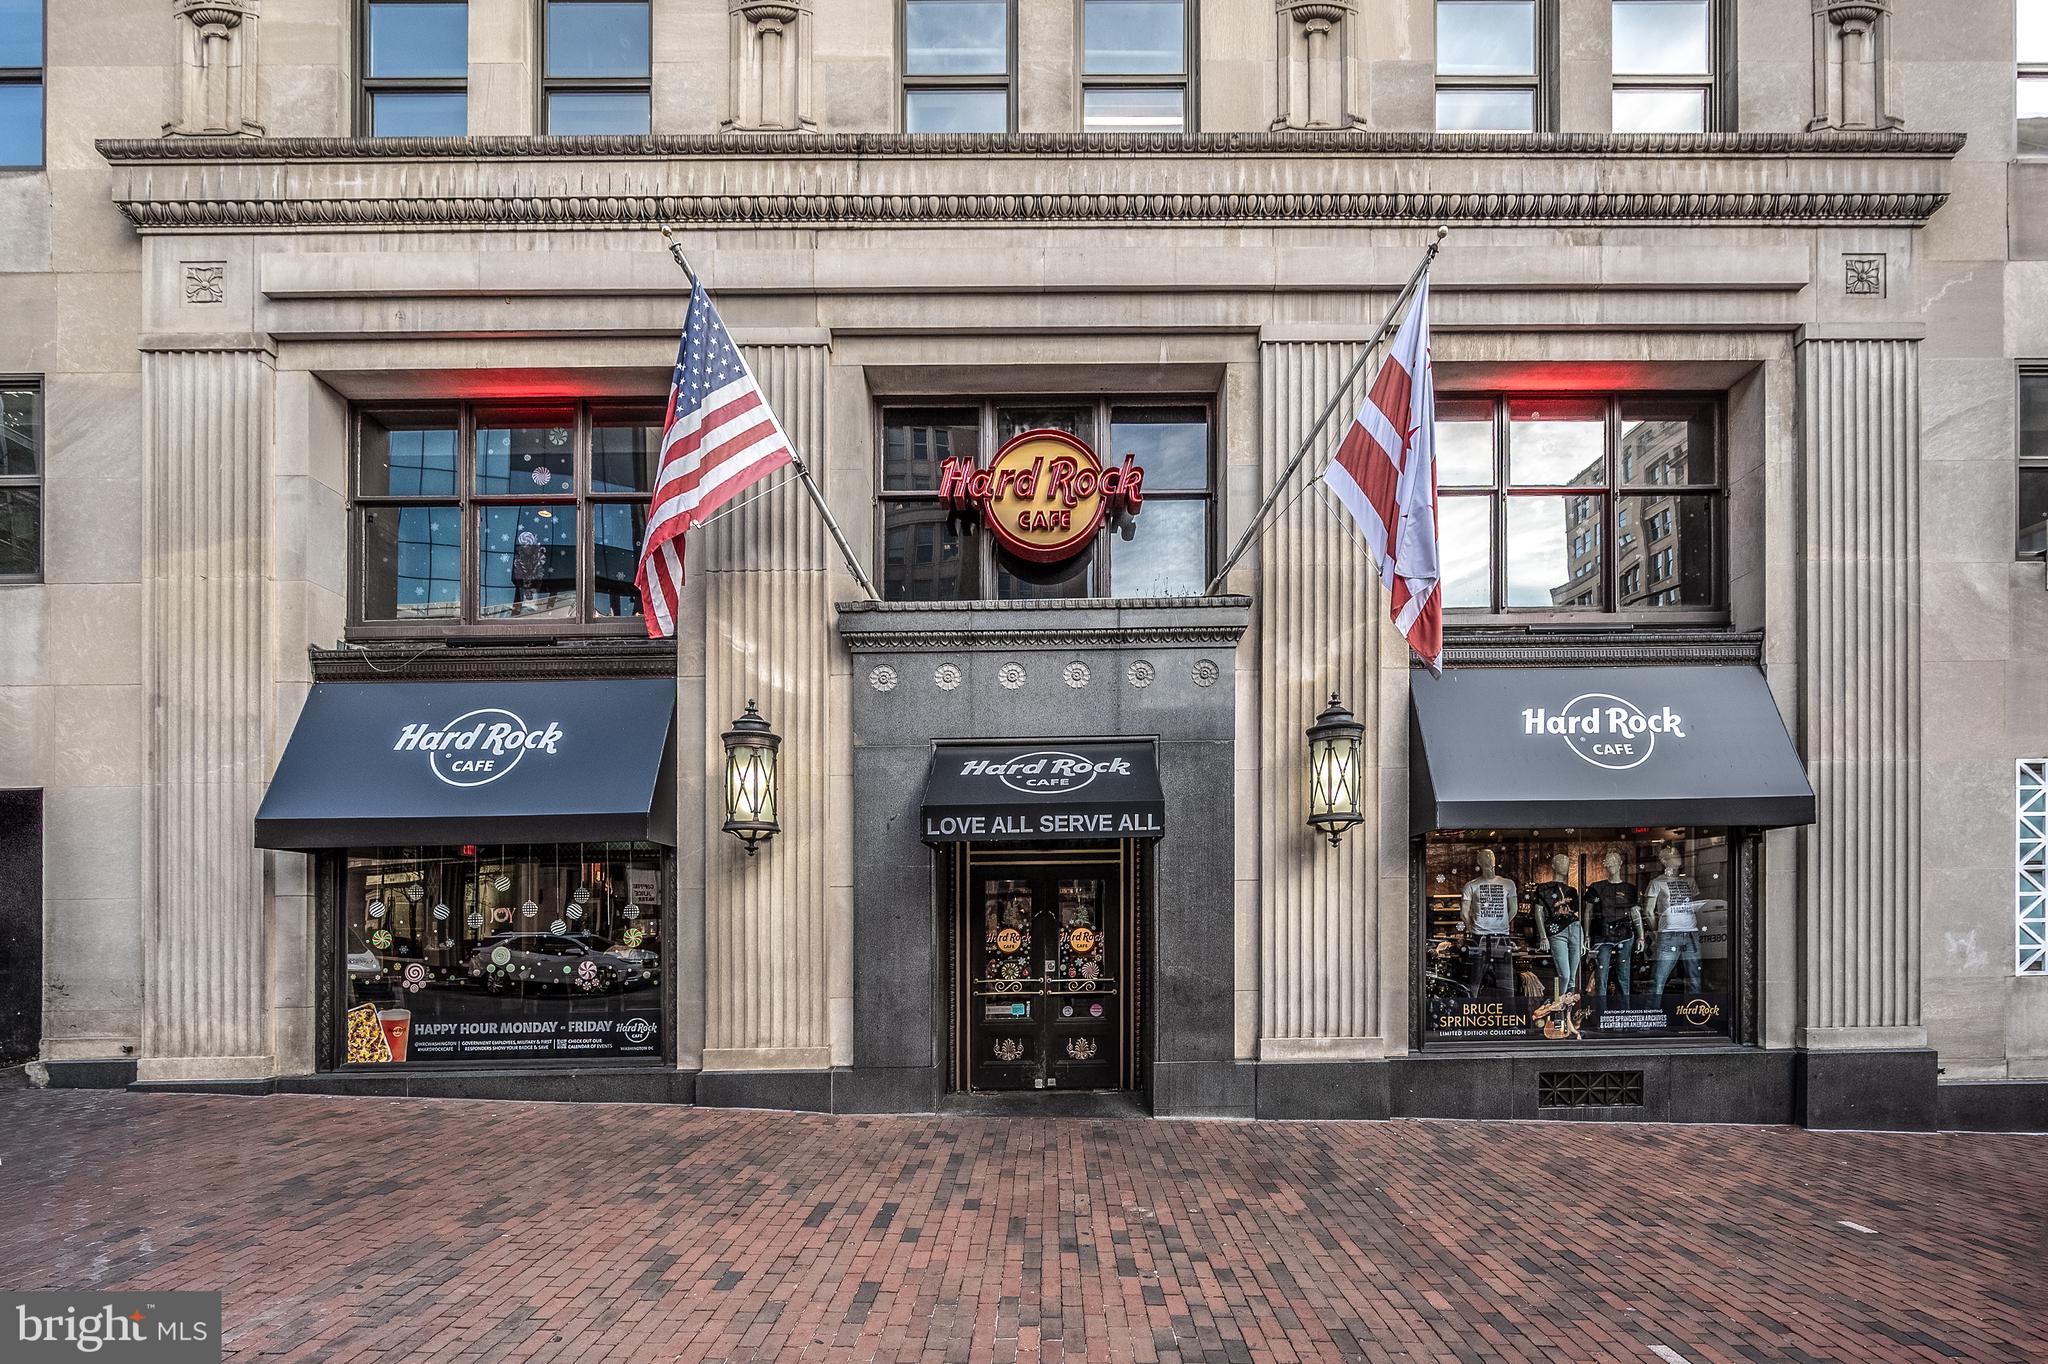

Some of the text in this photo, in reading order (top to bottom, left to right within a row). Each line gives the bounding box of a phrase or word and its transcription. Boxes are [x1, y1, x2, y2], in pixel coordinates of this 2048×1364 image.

[938, 454, 1145, 513] Hard Rock
[1018, 510, 1071, 532] CAFE
[1522, 706, 1686, 739] Hard Rock
[393, 722, 563, 756] Hard Rock
[1592, 743, 1634, 755] CAFE
[451, 760, 495, 772] CAFE
[960, 757, 1131, 777] Hard Rock
[1026, 778, 1070, 786] CAFE
[927, 813, 1161, 835] LOVE ALL SERVE ALL
[490, 907, 516, 923] JOY
[1463, 1003, 1503, 1015] BRUCE
[1676, 1005, 1720, 1017] Hard Rock
[414, 1023, 458, 1035] HAPPY
[460, 1022, 498, 1034] HOUR
[500, 1021, 558, 1033] MONDAY
[568, 1020, 613, 1032] FRIDAY
[616, 1022, 657, 1033] Hard Rock
[1439, 1015, 1526, 1028] SPRINGSTEEN
